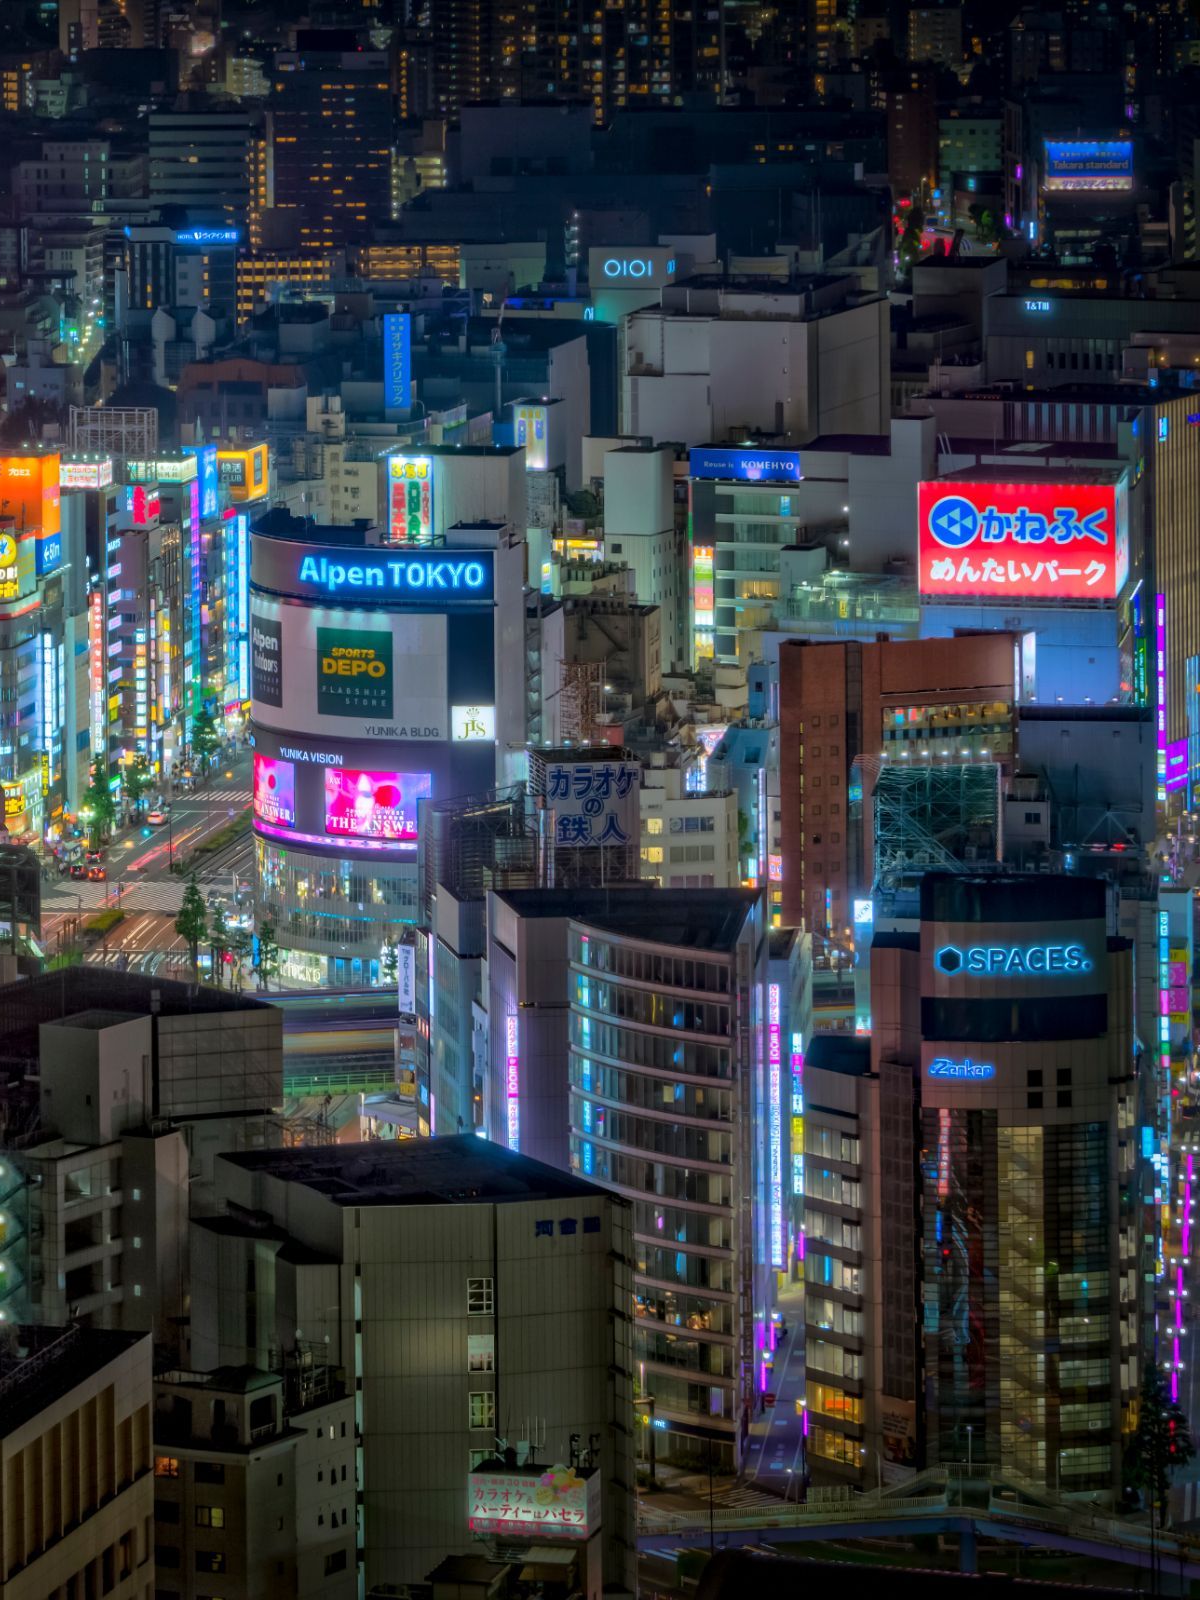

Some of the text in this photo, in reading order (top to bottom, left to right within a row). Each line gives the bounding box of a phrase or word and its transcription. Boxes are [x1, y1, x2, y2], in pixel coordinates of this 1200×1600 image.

[1086, 160, 1129, 169] standard
[8, 468, 31, 476] プロミス
[222, 462, 241, 473] 快活
[741, 460, 794, 471] KOMEHYO
[222, 474, 242, 482] CLUB
[980, 506, 1108, 545] かねふく
[301, 555, 484, 590] Alpen TOKYO
[930, 557, 1106, 586] めんたいパーク
[253, 627, 278, 651] Alpen
[331, 647, 375, 658] SPORTS
[322, 658, 386, 677] DEPO
[321, 686, 386, 697] FLAGSHIP
[345, 697, 387, 707] STORE
[365, 726, 407, 738] YUNIKA
[280, 747, 343, 765] YUNIKA VISION
[548, 764, 639, 800] カラオケ
[582, 796, 605, 818] の
[362, 819, 417, 833] ANSWE
[555, 813, 632, 846] 鉄人
